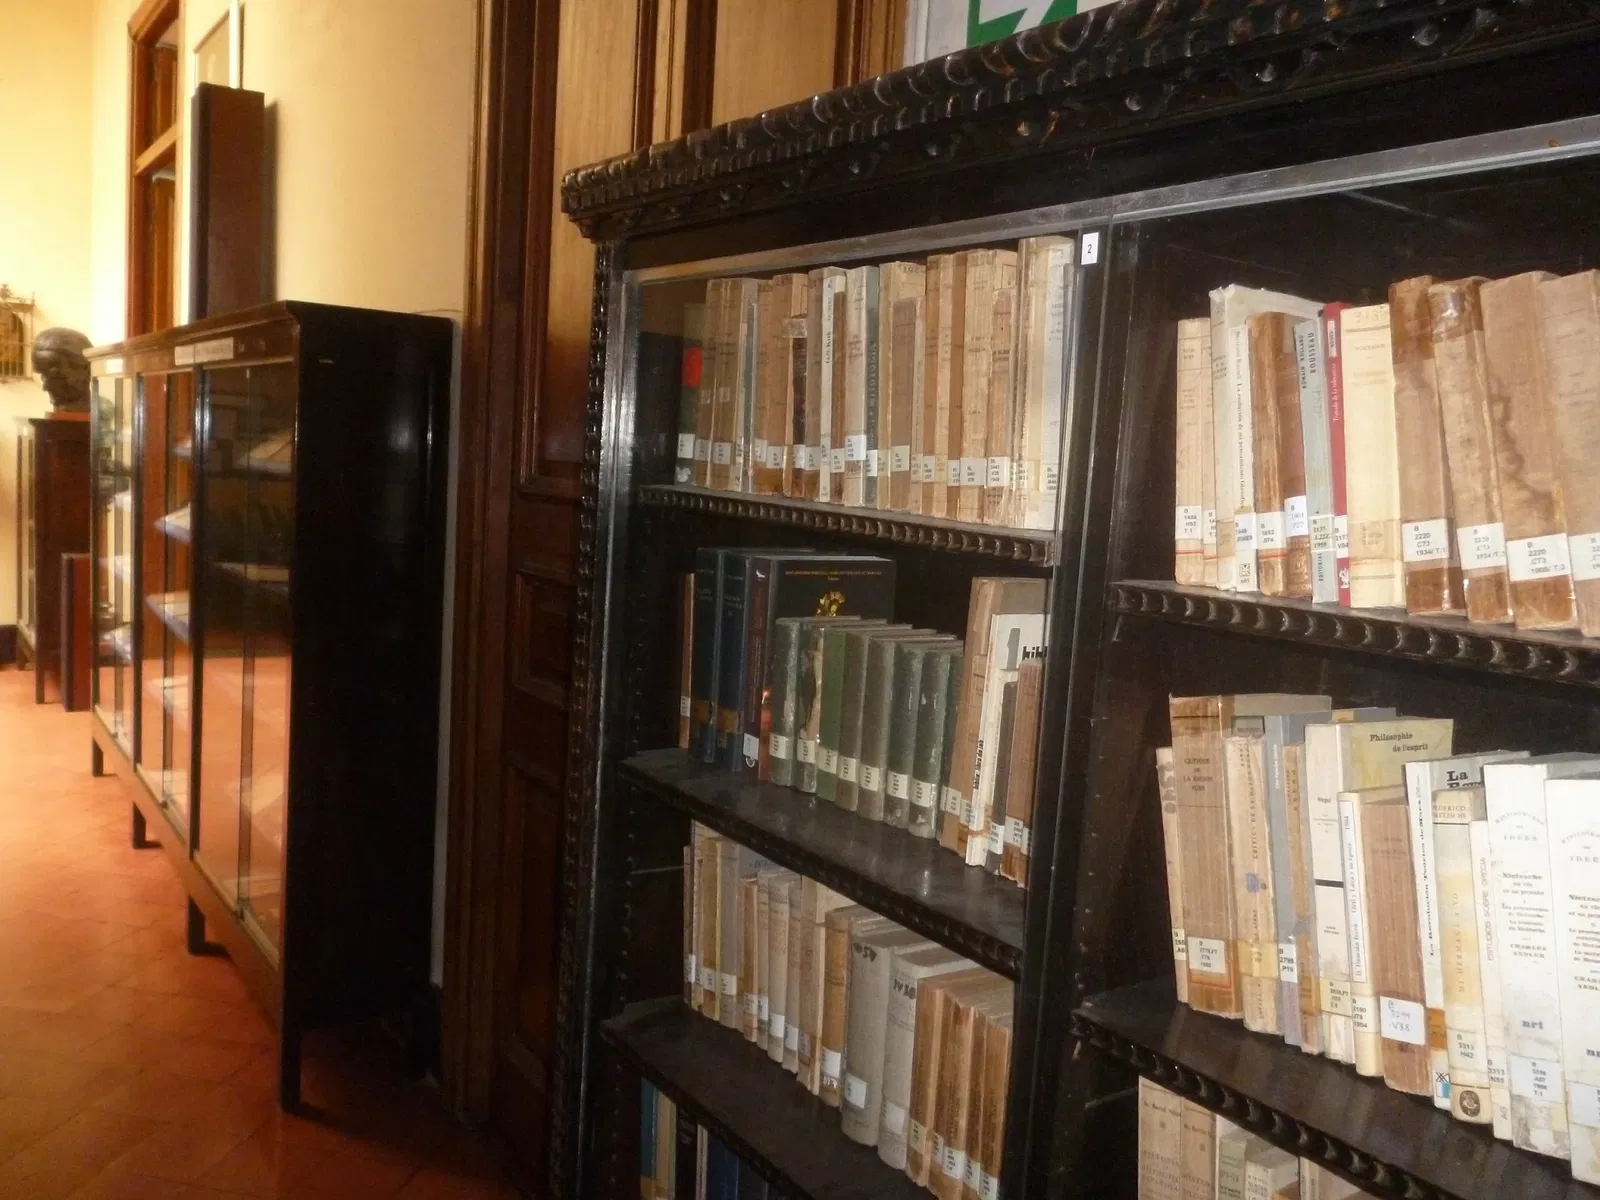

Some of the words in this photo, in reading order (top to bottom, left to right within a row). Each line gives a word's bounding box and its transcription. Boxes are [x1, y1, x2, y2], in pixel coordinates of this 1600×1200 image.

[1087, 244, 1092, 254] 2
[1308, 332, 1317, 374] ROUSSEAU
[1528, 549, 1547, 557] 2220
[1370, 733, 1413, 742] Philosophie
[1402, 743, 1428, 752] l'esprit
[1446, 770, 1468, 782] La
[1480, 857, 1488, 887] GRECIA
[1502, 872, 1543, 880] Nietzsche
[1482, 890, 1491, 920] SOBRE
[1485, 920, 1494, 961] ESTUDIOS
